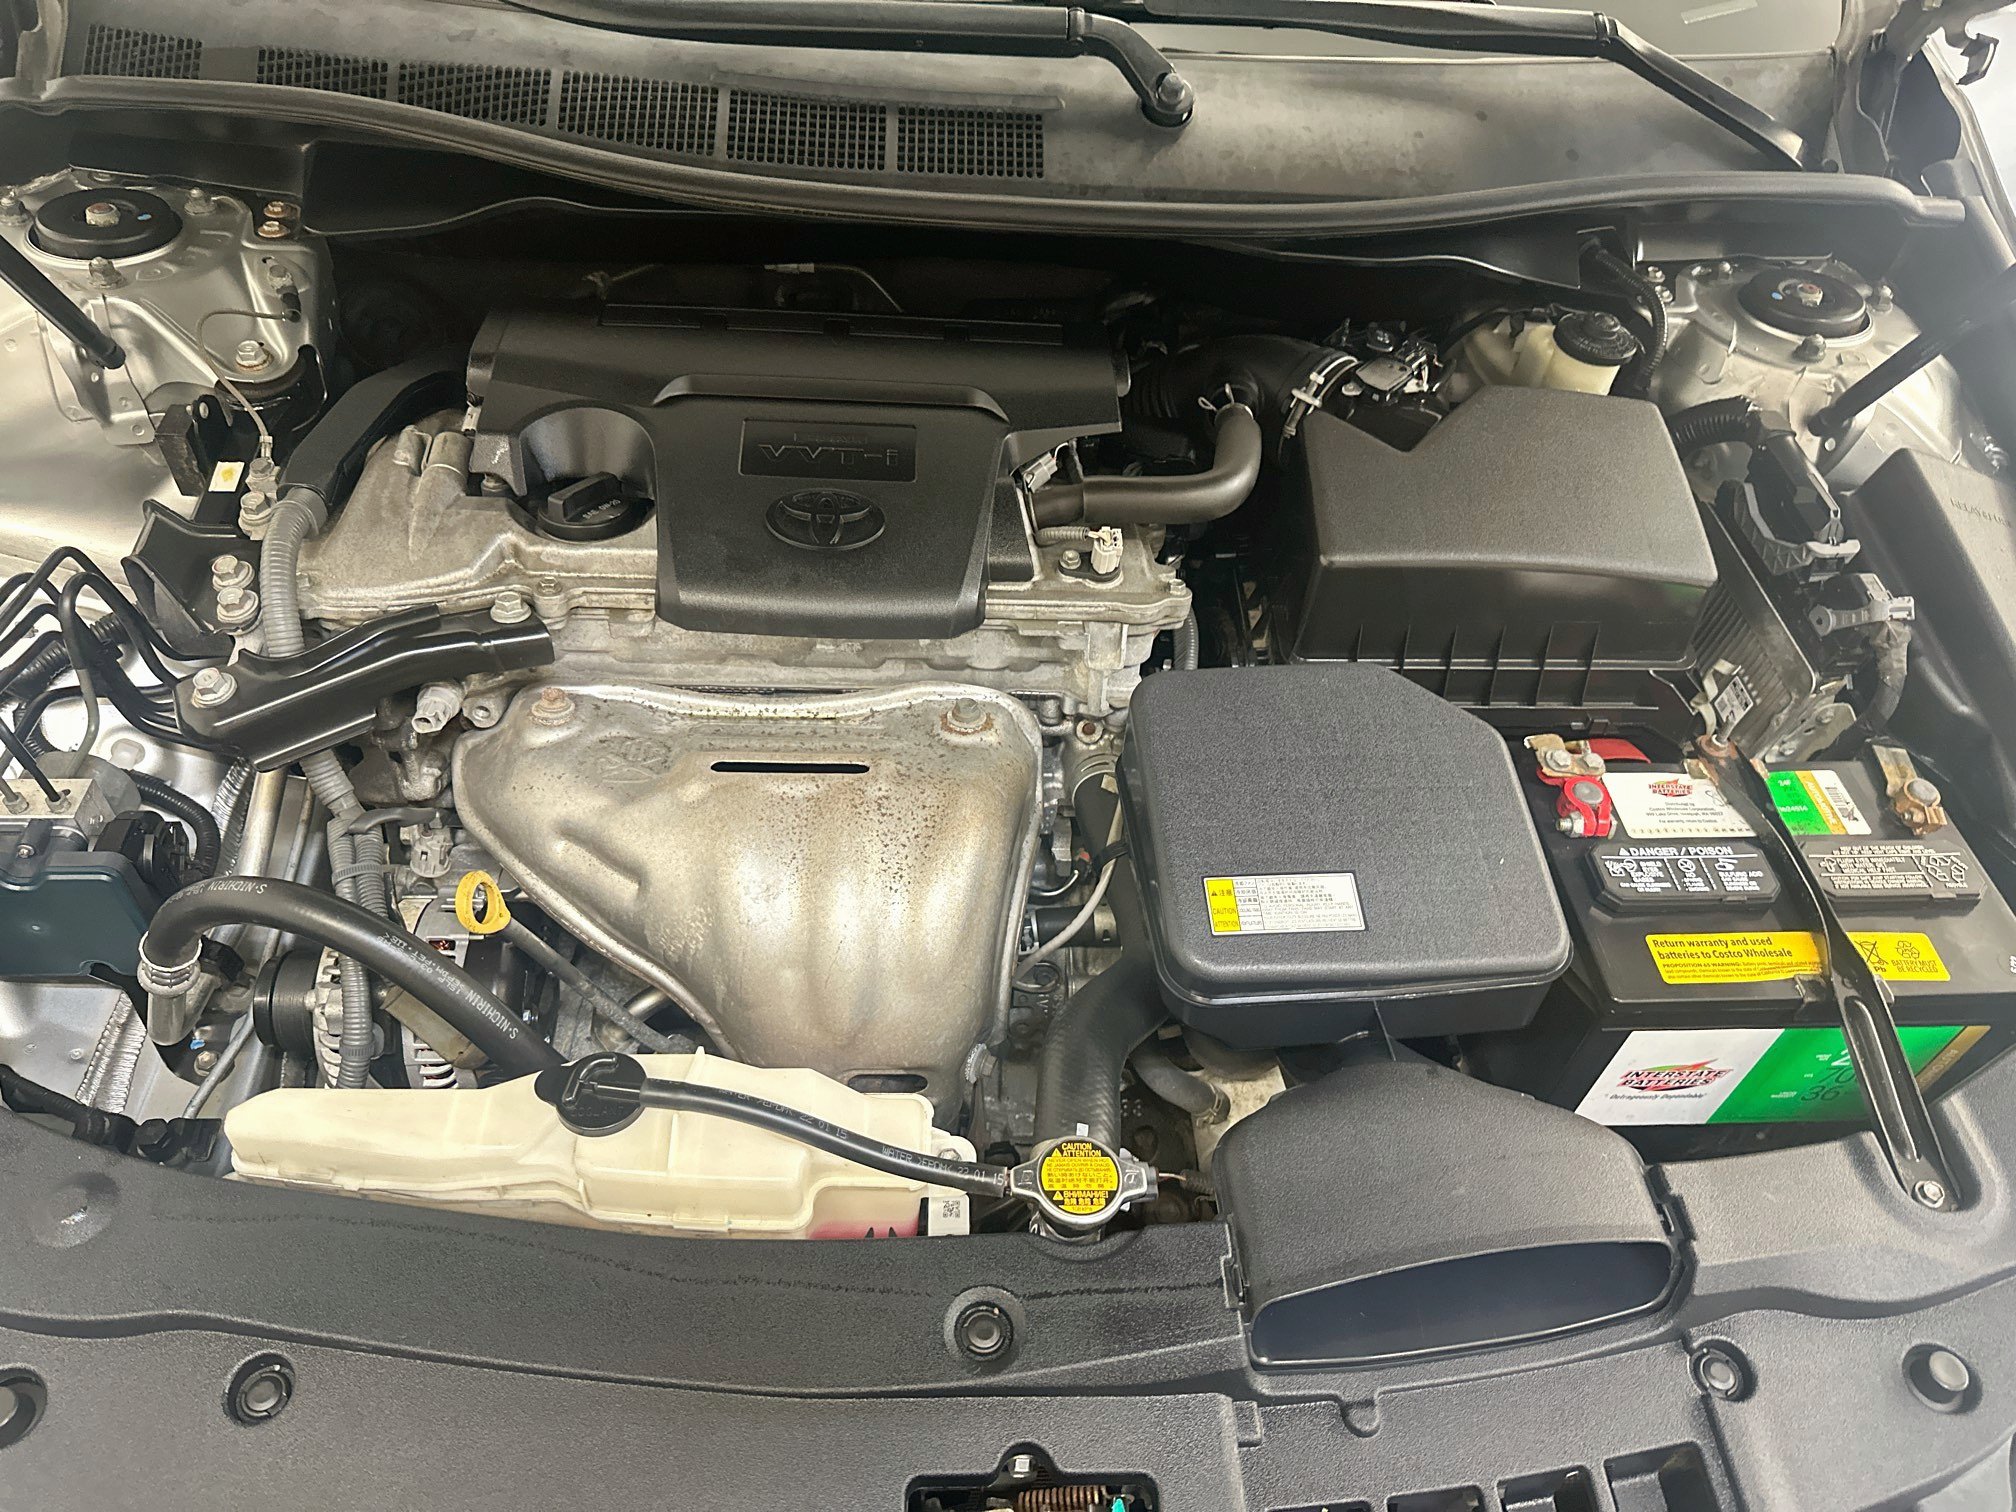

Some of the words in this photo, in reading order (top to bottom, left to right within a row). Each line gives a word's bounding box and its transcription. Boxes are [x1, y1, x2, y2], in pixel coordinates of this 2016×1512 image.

[757, 443, 900, 466] VVT-i
[1629, 847, 1678, 856] DANGER
[1690, 846, 1734, 855] POISON
[1215, 920, 1239, 928] ATTENTION
[1652, 938, 1685, 948] Return
[1686, 938, 1729, 949] warranty
[1730, 937, 1749, 946] and
[1750, 937, 1773, 946] used
[1657, 950, 1700, 960] batteries
[1702, 950, 1712, 959] to
[1712, 949, 1743, 959] Costco
[1743, 948, 1793, 958] Wholesale
[1891, 959, 1919, 967] BATTERY
[1919, 959, 1937, 967] MUST
[1623, 1070, 1725, 1079] INTERSTATE
[1621, 1078, 1714, 1086] BATTERIES
[1061, 1142, 1092, 1150] CAUTION
[881, 1145, 913, 1164] WATER
[1062, 1149, 1102, 1157] ATTENTION
